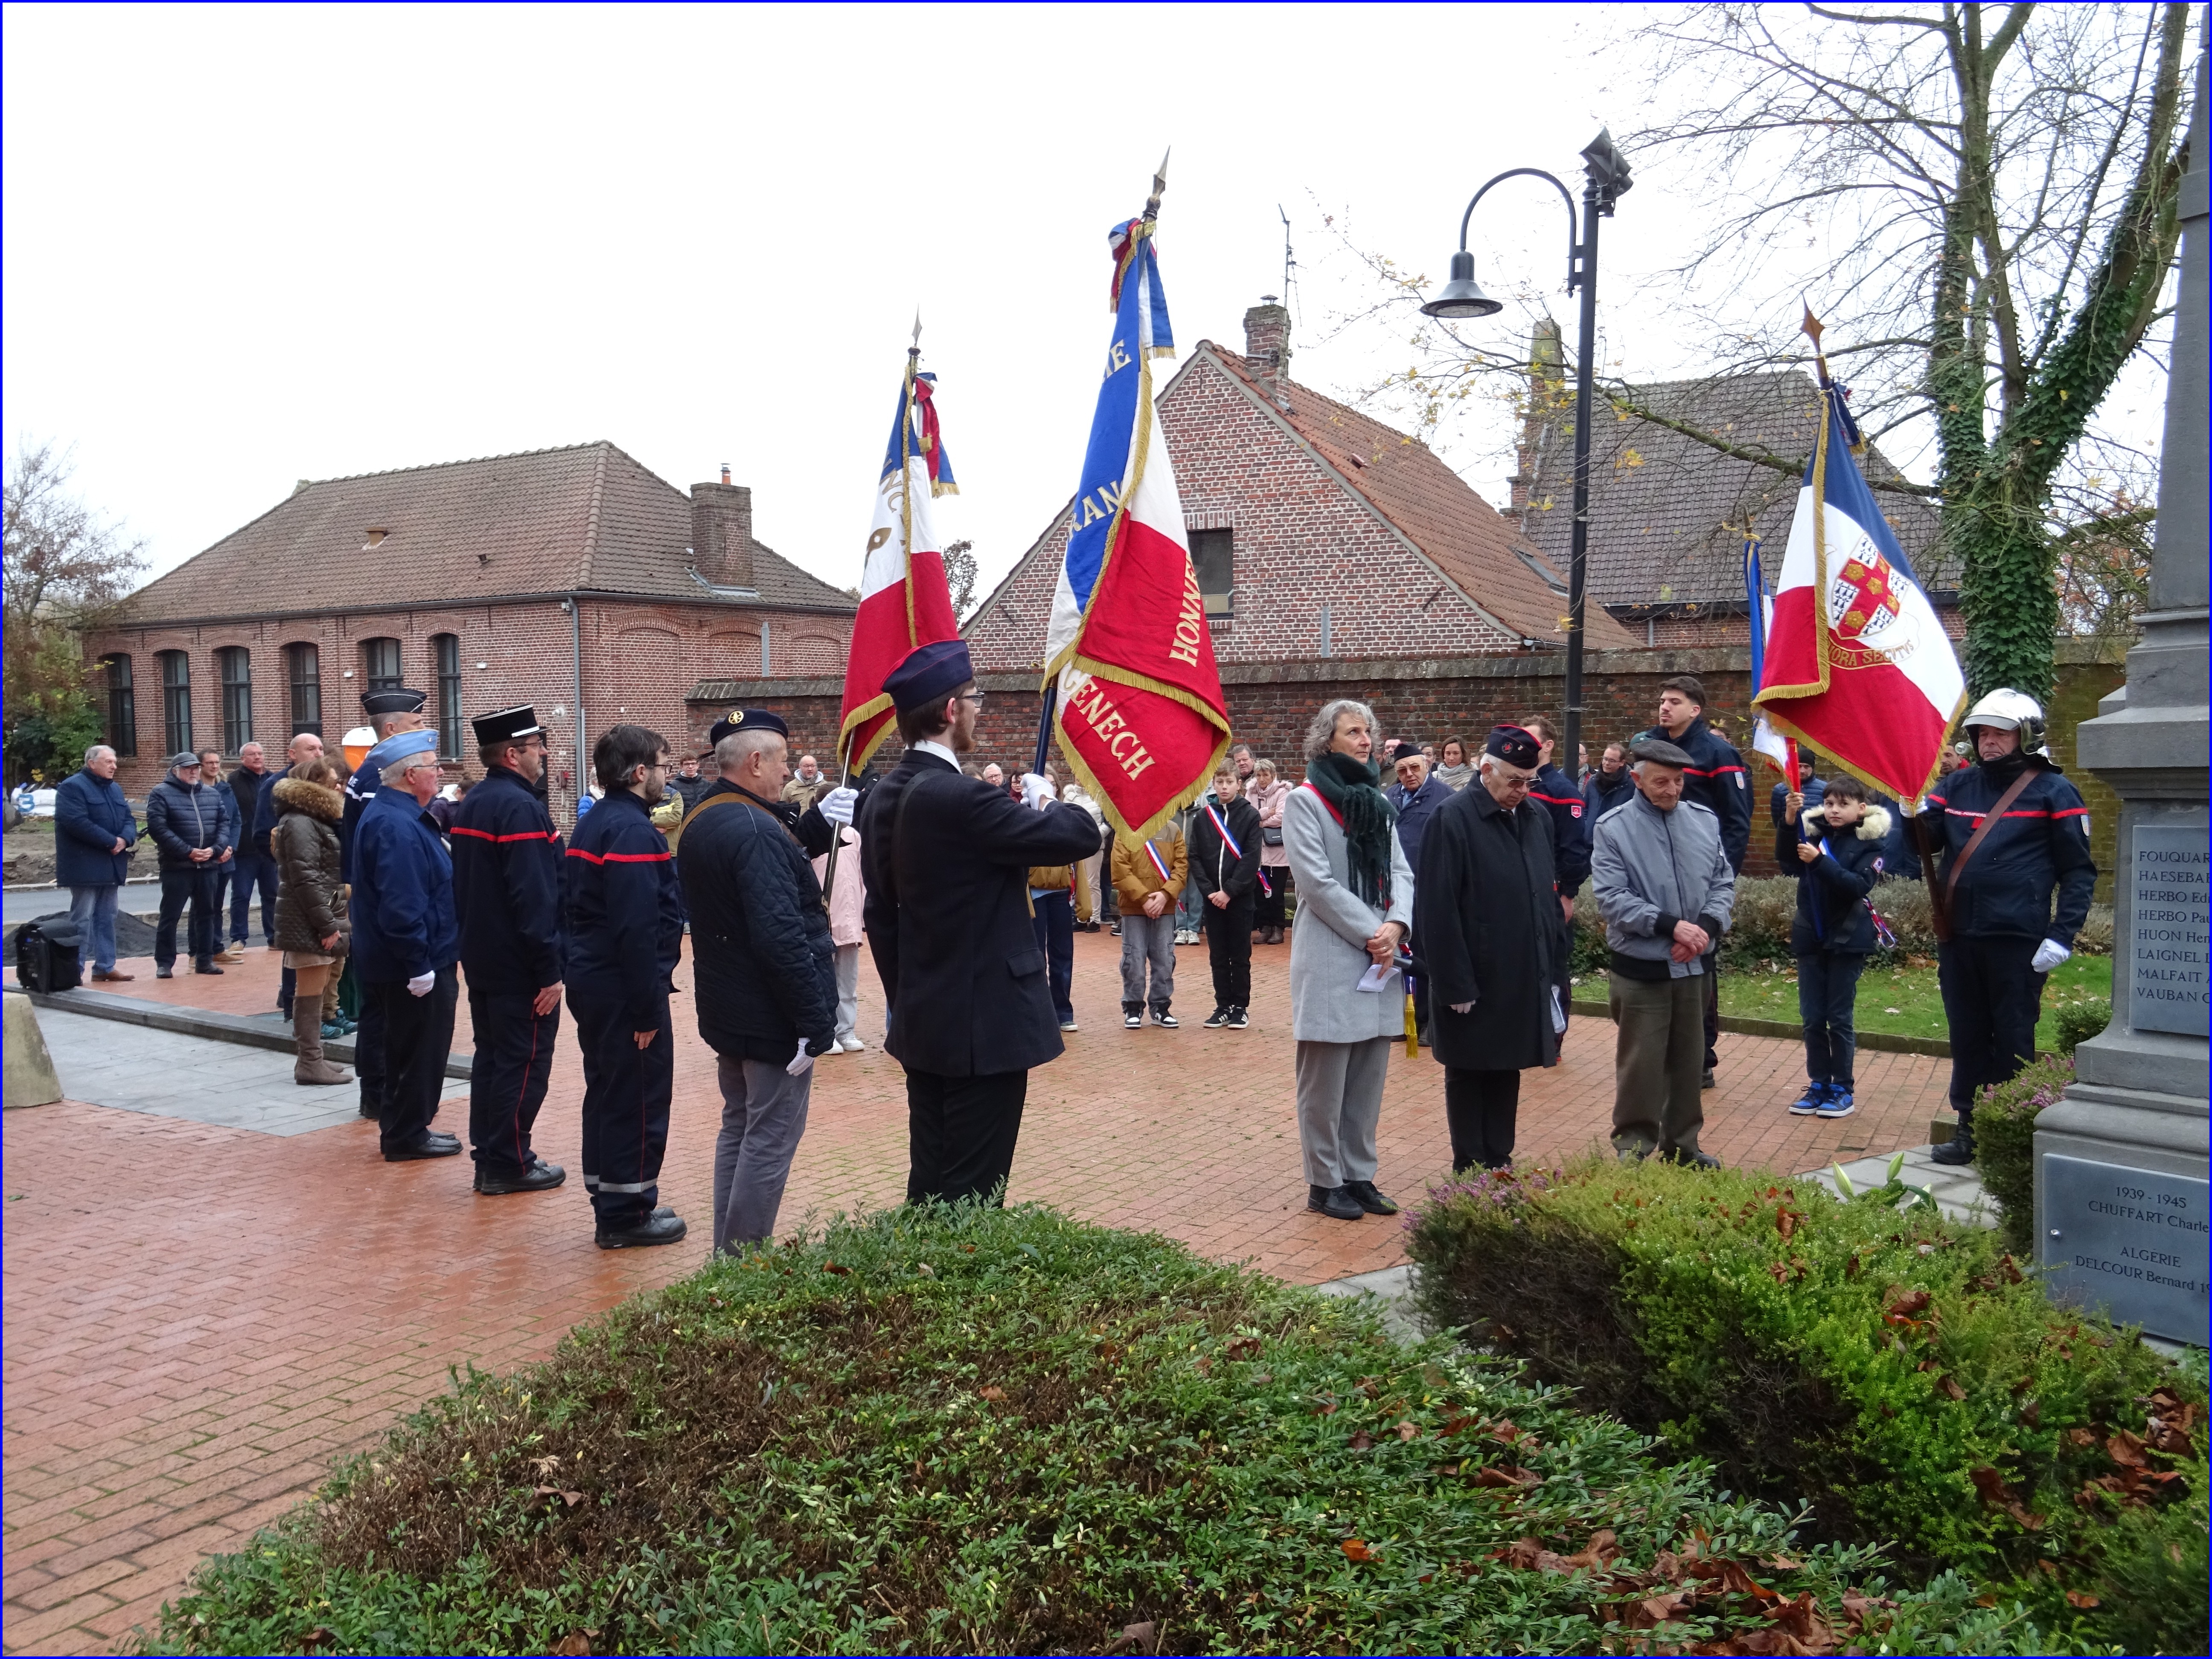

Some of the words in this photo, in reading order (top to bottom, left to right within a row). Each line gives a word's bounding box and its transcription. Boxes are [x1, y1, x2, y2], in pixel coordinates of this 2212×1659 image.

[1063, 664, 1155, 781] GENECH
[2139, 851, 2209, 863] FOUQUAR
[2139, 890, 2187, 902] HERBO
[2192, 892, 2209, 903] Ed
[2139, 910, 2186, 922] HERBO
[2138, 929, 2181, 941] HUON
[2138, 948, 2201, 963] LAIGNEL
[2137, 968, 2202, 983] MALFAIT
[2136, 987, 2197, 1002] VAUBAN
[2116, 1187, 2144, 1200] 1939
[2157, 1194, 2186, 1208] 1945
[2088, 1200, 2163, 1224] CHUFFART
[2167, 1215, 2209, 1233] Charle
[2120, 1246, 2181, 1267] ALGÉRIE
[2075, 1255, 2143, 1280] DELCOUR
[2146, 1271, 2194, 1290] Bernard
